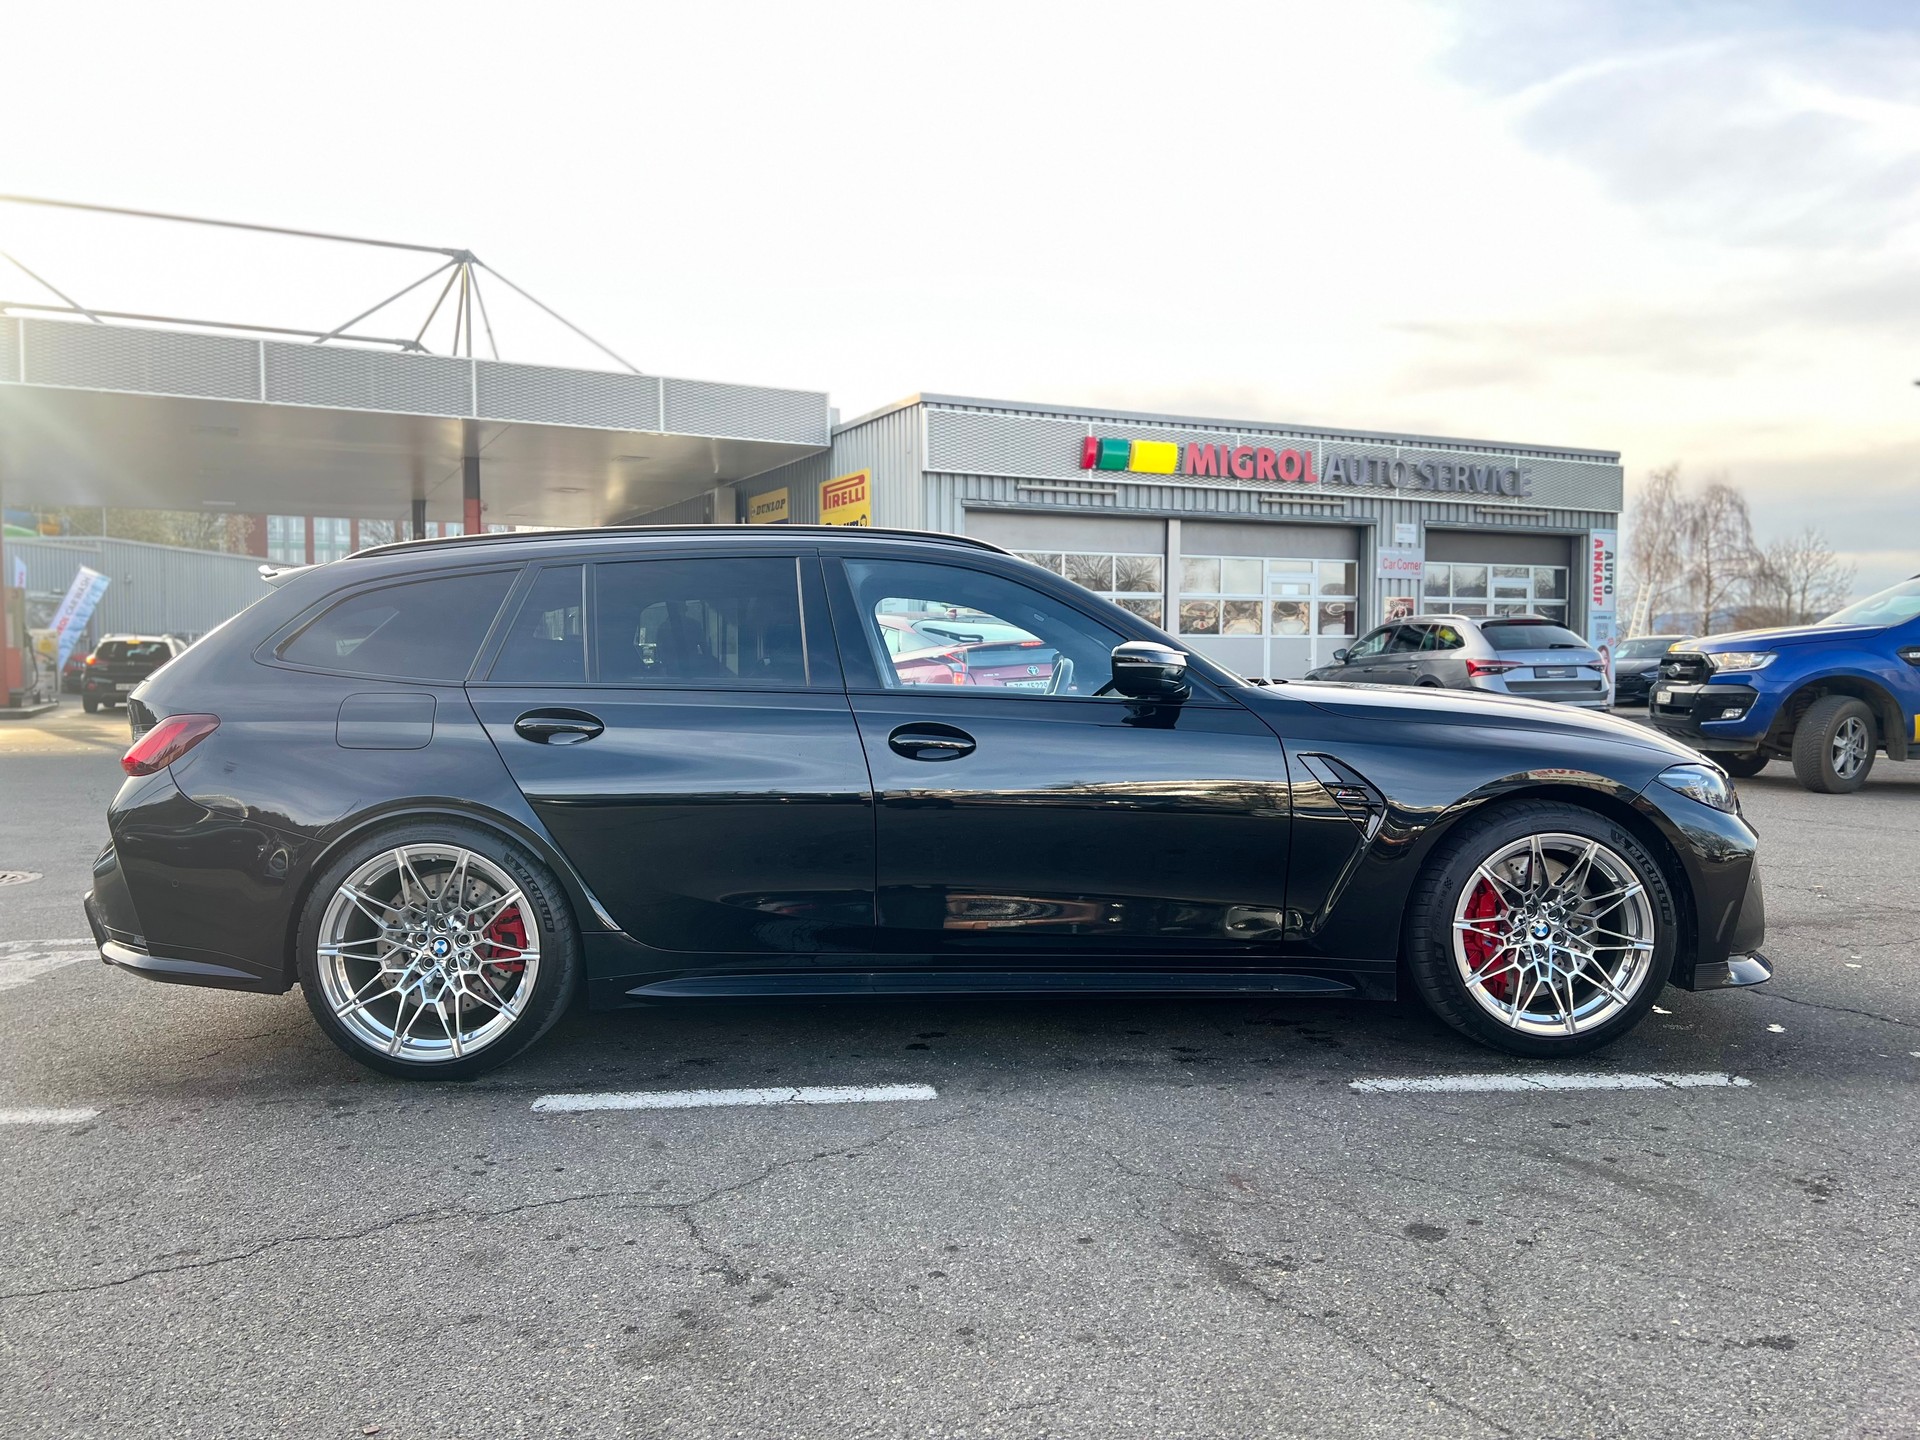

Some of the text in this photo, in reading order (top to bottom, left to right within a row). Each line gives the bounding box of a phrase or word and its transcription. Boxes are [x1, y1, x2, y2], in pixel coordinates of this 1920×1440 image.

[822, 474, 866, 511] PIRELLI
[1184, 442, 1533, 497] MIGROL AUTO SERVICE
[756, 498, 786, 516] DUNLOP
[1382, 558, 1422, 571] Car Corner
[1593, 538, 1604, 606] ANKAUF
[1604, 550, 1614, 595] AUTO
[518, 868, 554, 931] MICHELIN
[1627, 845, 1672, 920] MICHELIN
